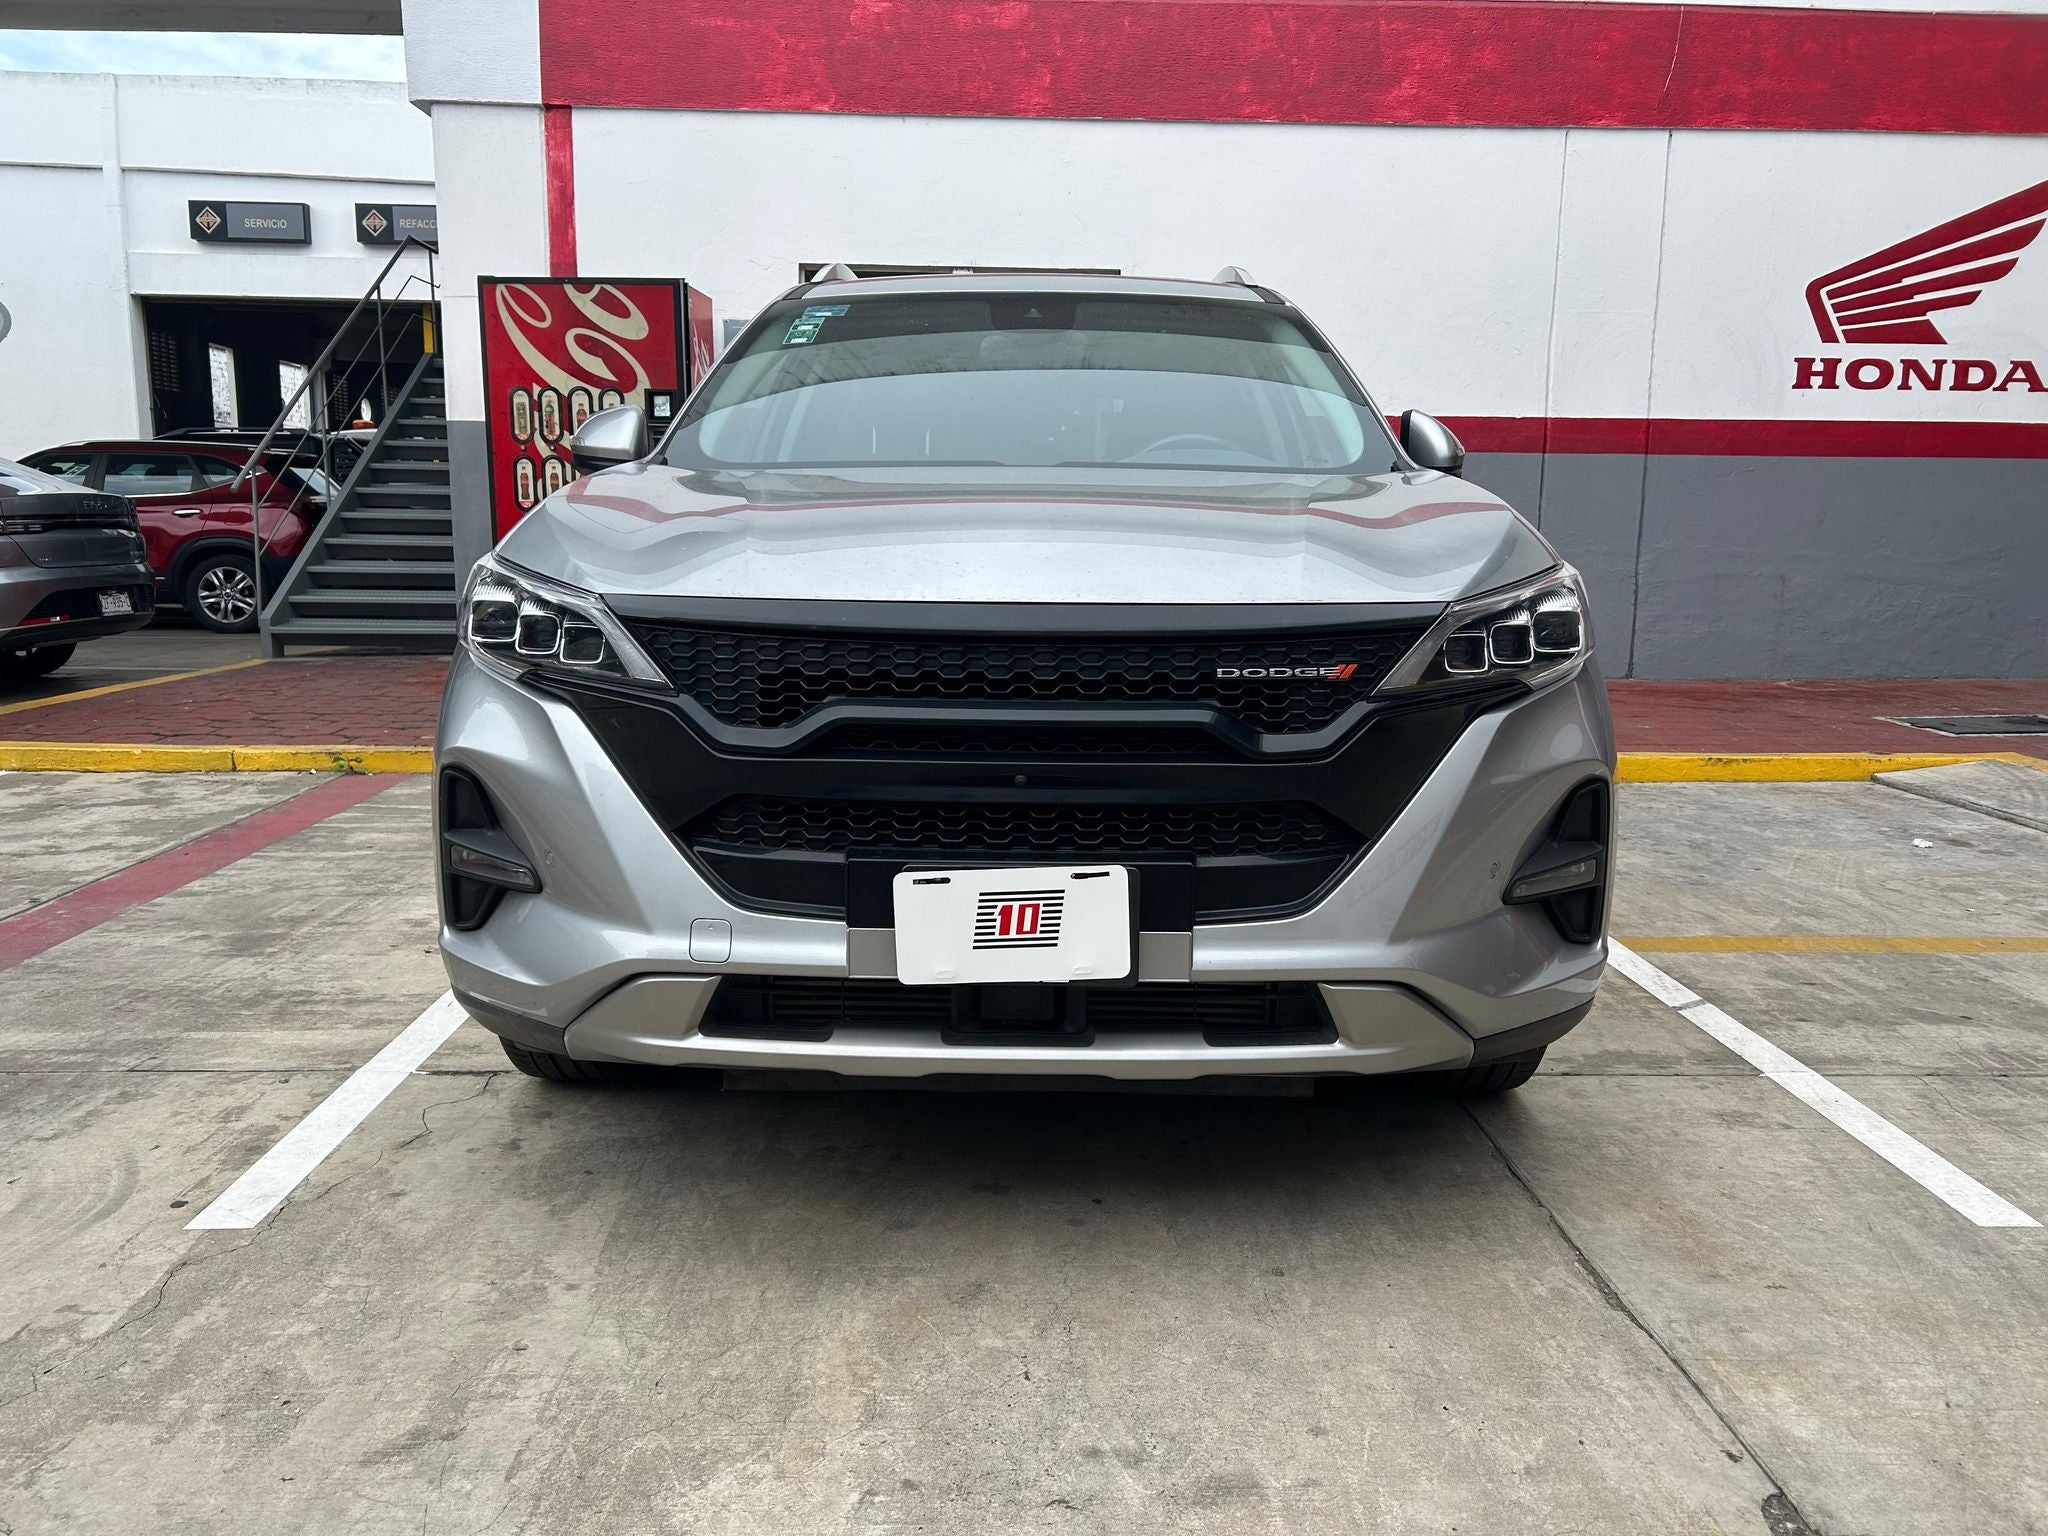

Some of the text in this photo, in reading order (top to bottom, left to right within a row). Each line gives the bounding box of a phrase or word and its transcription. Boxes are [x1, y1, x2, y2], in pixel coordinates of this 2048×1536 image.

[244, 218, 287, 228] SERVICIO
[1792, 357, 2048, 392] HONDA
[1217, 667, 1341, 678] DODGE
[998, 903, 1040, 935] 10
